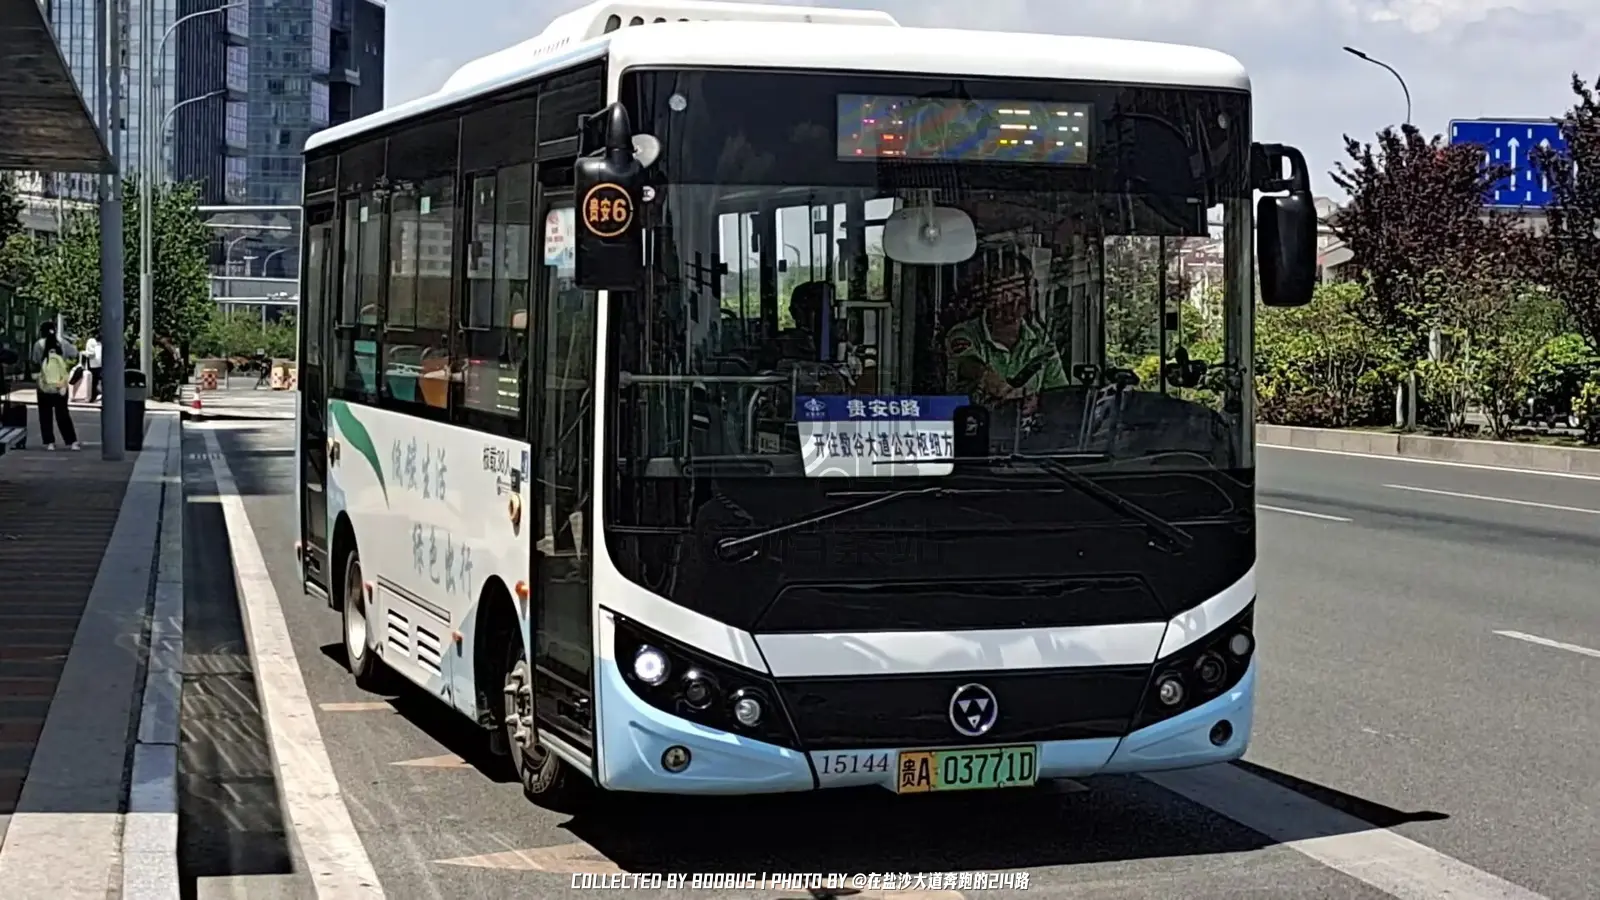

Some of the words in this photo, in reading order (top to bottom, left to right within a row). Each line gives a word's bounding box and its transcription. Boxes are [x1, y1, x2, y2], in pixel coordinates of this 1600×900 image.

[846, 399, 920, 417] 贵安6路
[821, 753, 890, 774] 15144
[901, 758, 931, 787] 贵A
[944, 752, 1033, 784] 03771D
